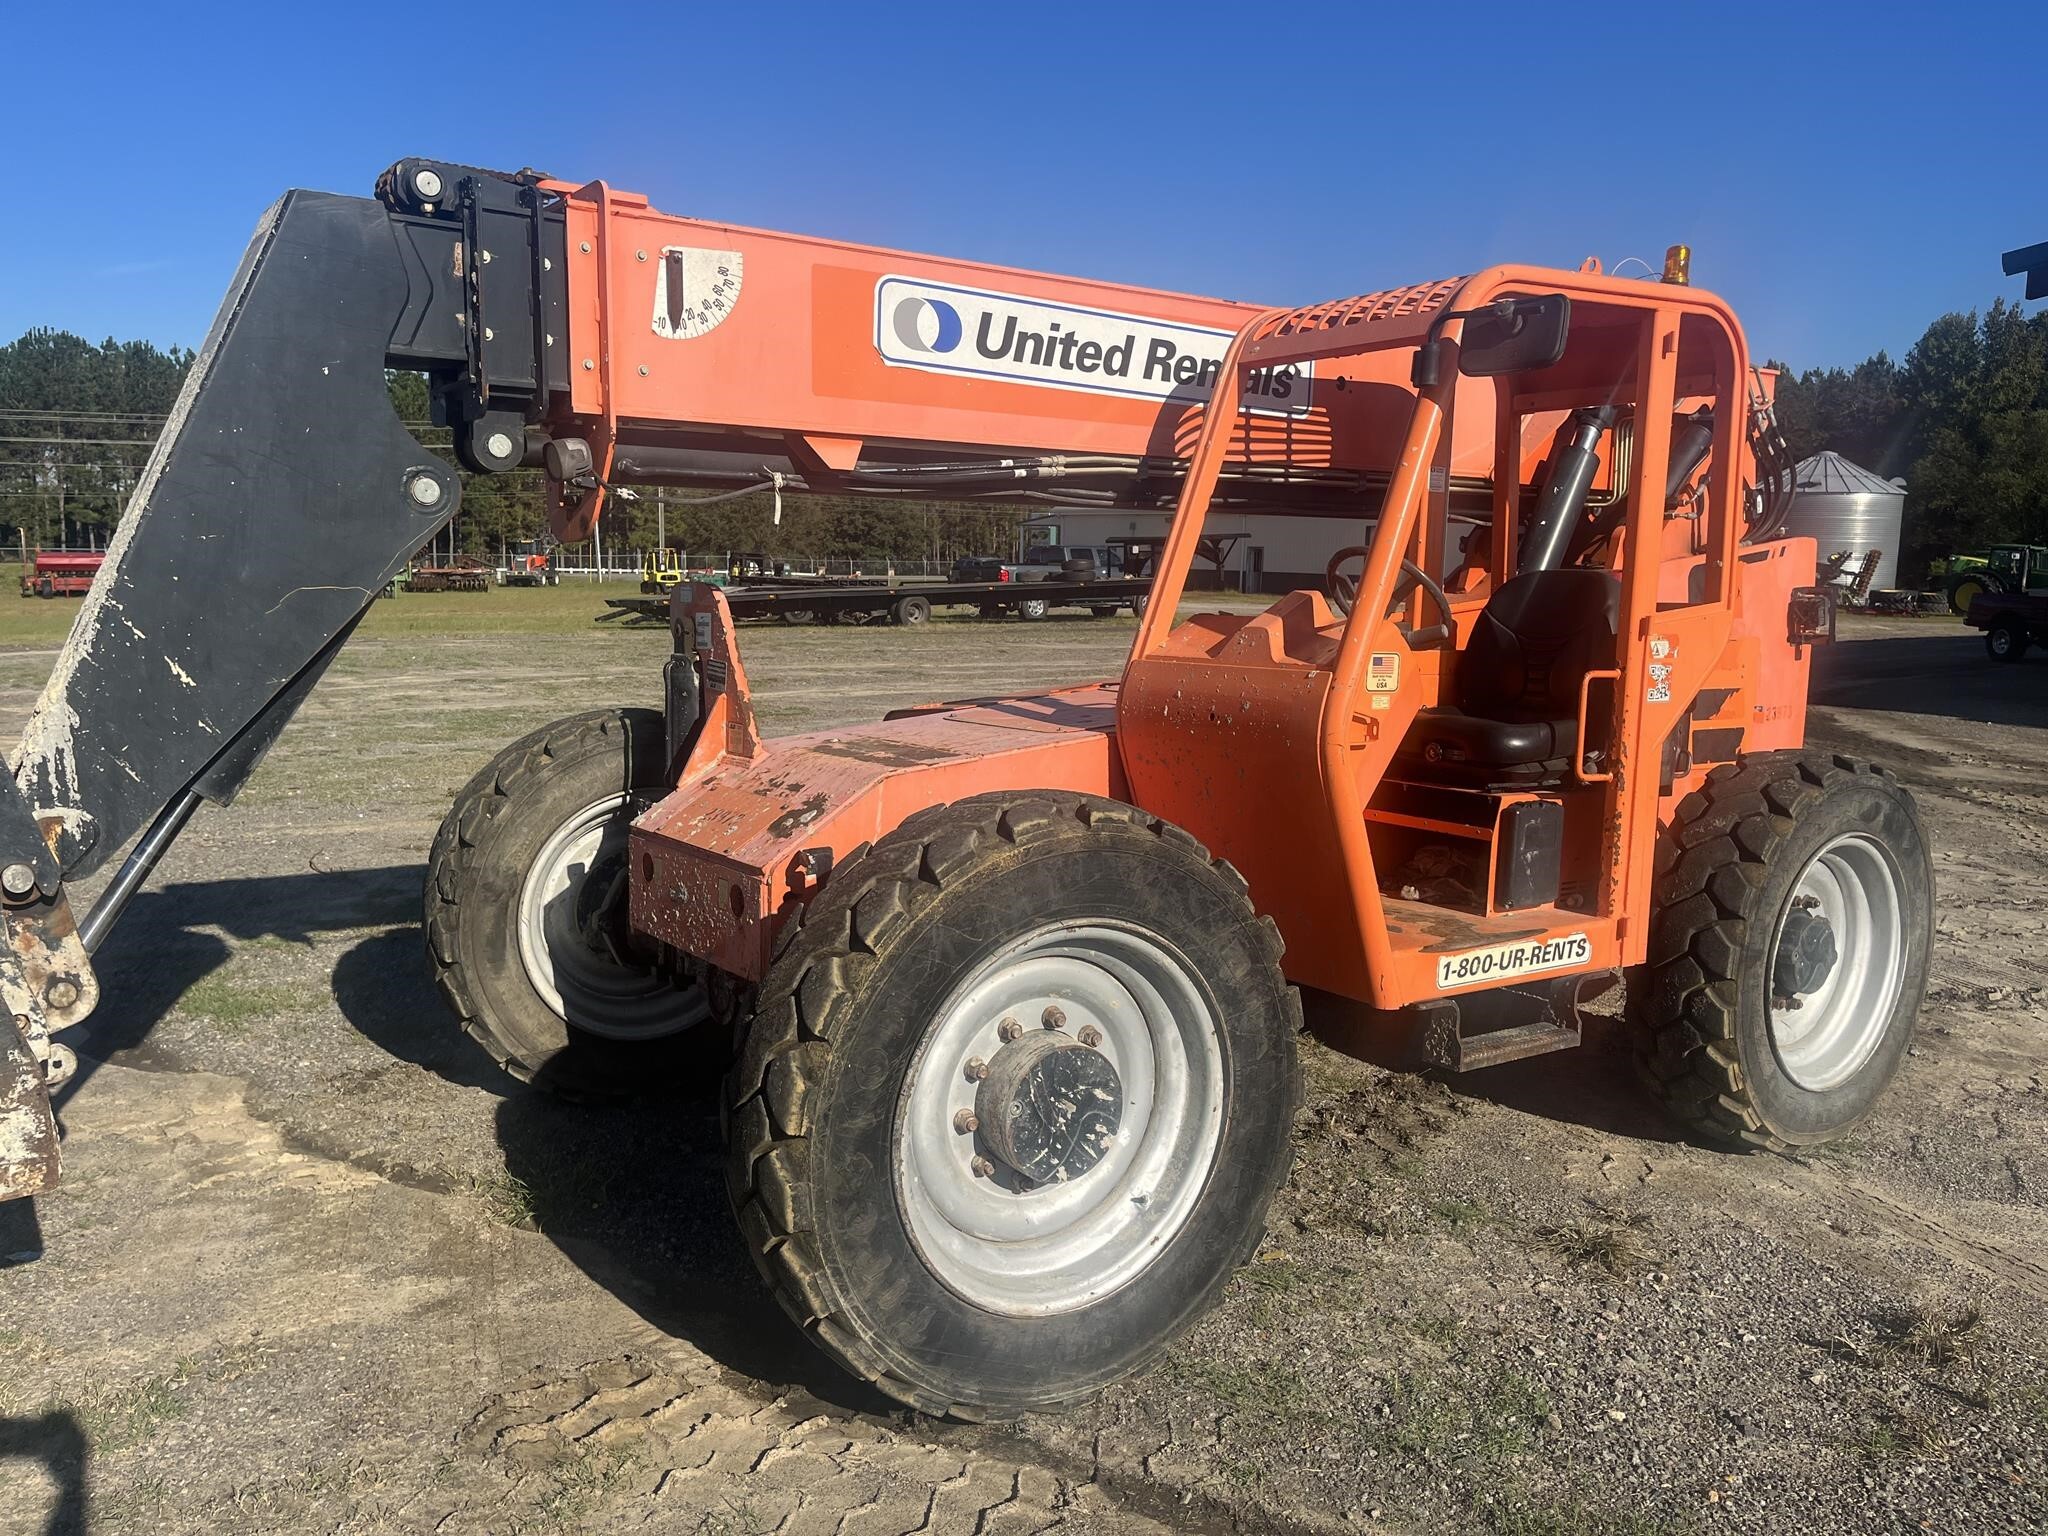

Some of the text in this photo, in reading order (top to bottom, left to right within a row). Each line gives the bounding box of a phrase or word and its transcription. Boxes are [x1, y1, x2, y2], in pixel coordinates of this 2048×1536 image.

[717, 266, 729, 277] 80
[712, 284, 724, 297] 60
[723, 278, 735, 290] 70
[701, 298, 713, 312] 40
[713, 298, 725, 311] 50
[685, 307, 695, 321] 20
[697, 311, 708, 325] 30
[975, 312, 1294, 399] United Renals
[1442, 937, 1587, 981] 1-800-UR-RENTS
